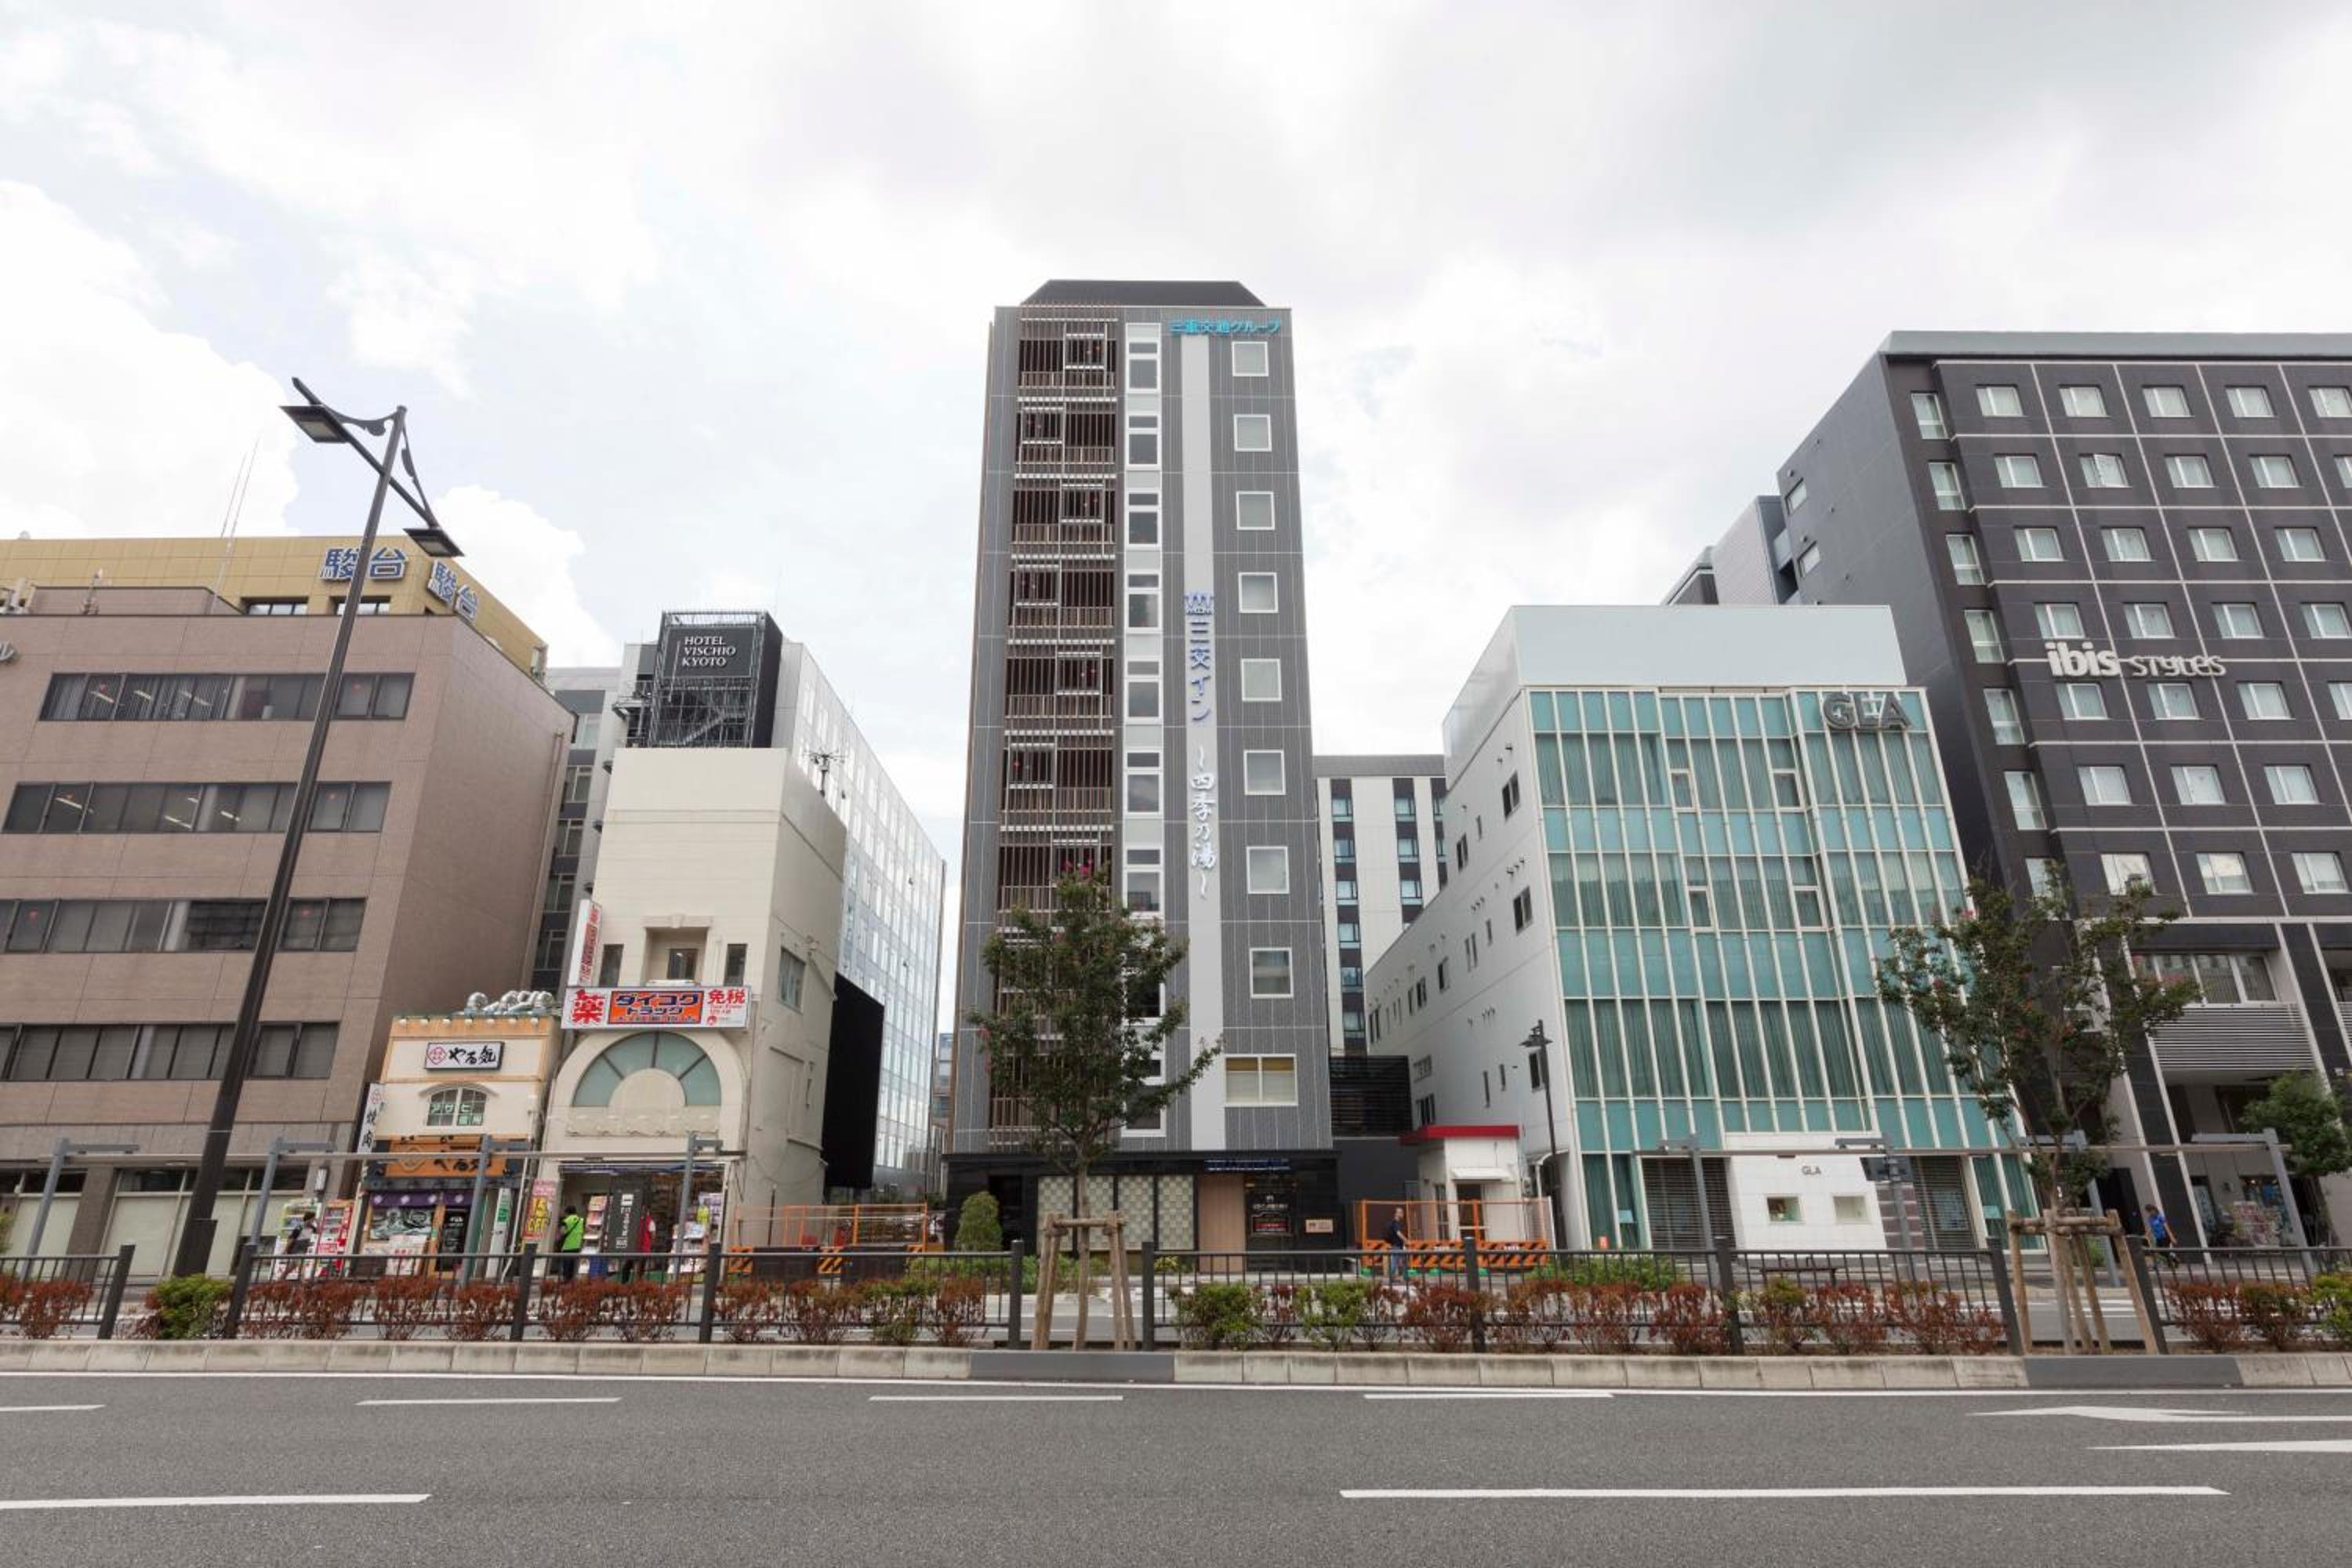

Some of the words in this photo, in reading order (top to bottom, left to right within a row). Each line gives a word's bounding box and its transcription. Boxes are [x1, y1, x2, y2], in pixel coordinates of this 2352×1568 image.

[427, 560, 477, 625] 駿台
[684, 636, 727, 645] HOTEL
[684, 645, 737, 656] VISCHIO
[681, 656, 728, 667] KYOTO
[2045, 641, 2121, 677] ibis
[1189, 619, 1212, 723] 三交イン
[1823, 691, 1914, 731] GLA
[615, 993, 699, 1007] ダイコク
[707, 989, 746, 1004] 免税
[572, 988, 606, 1024] 薬
[1802, 1165, 1822, 1175] GLA
